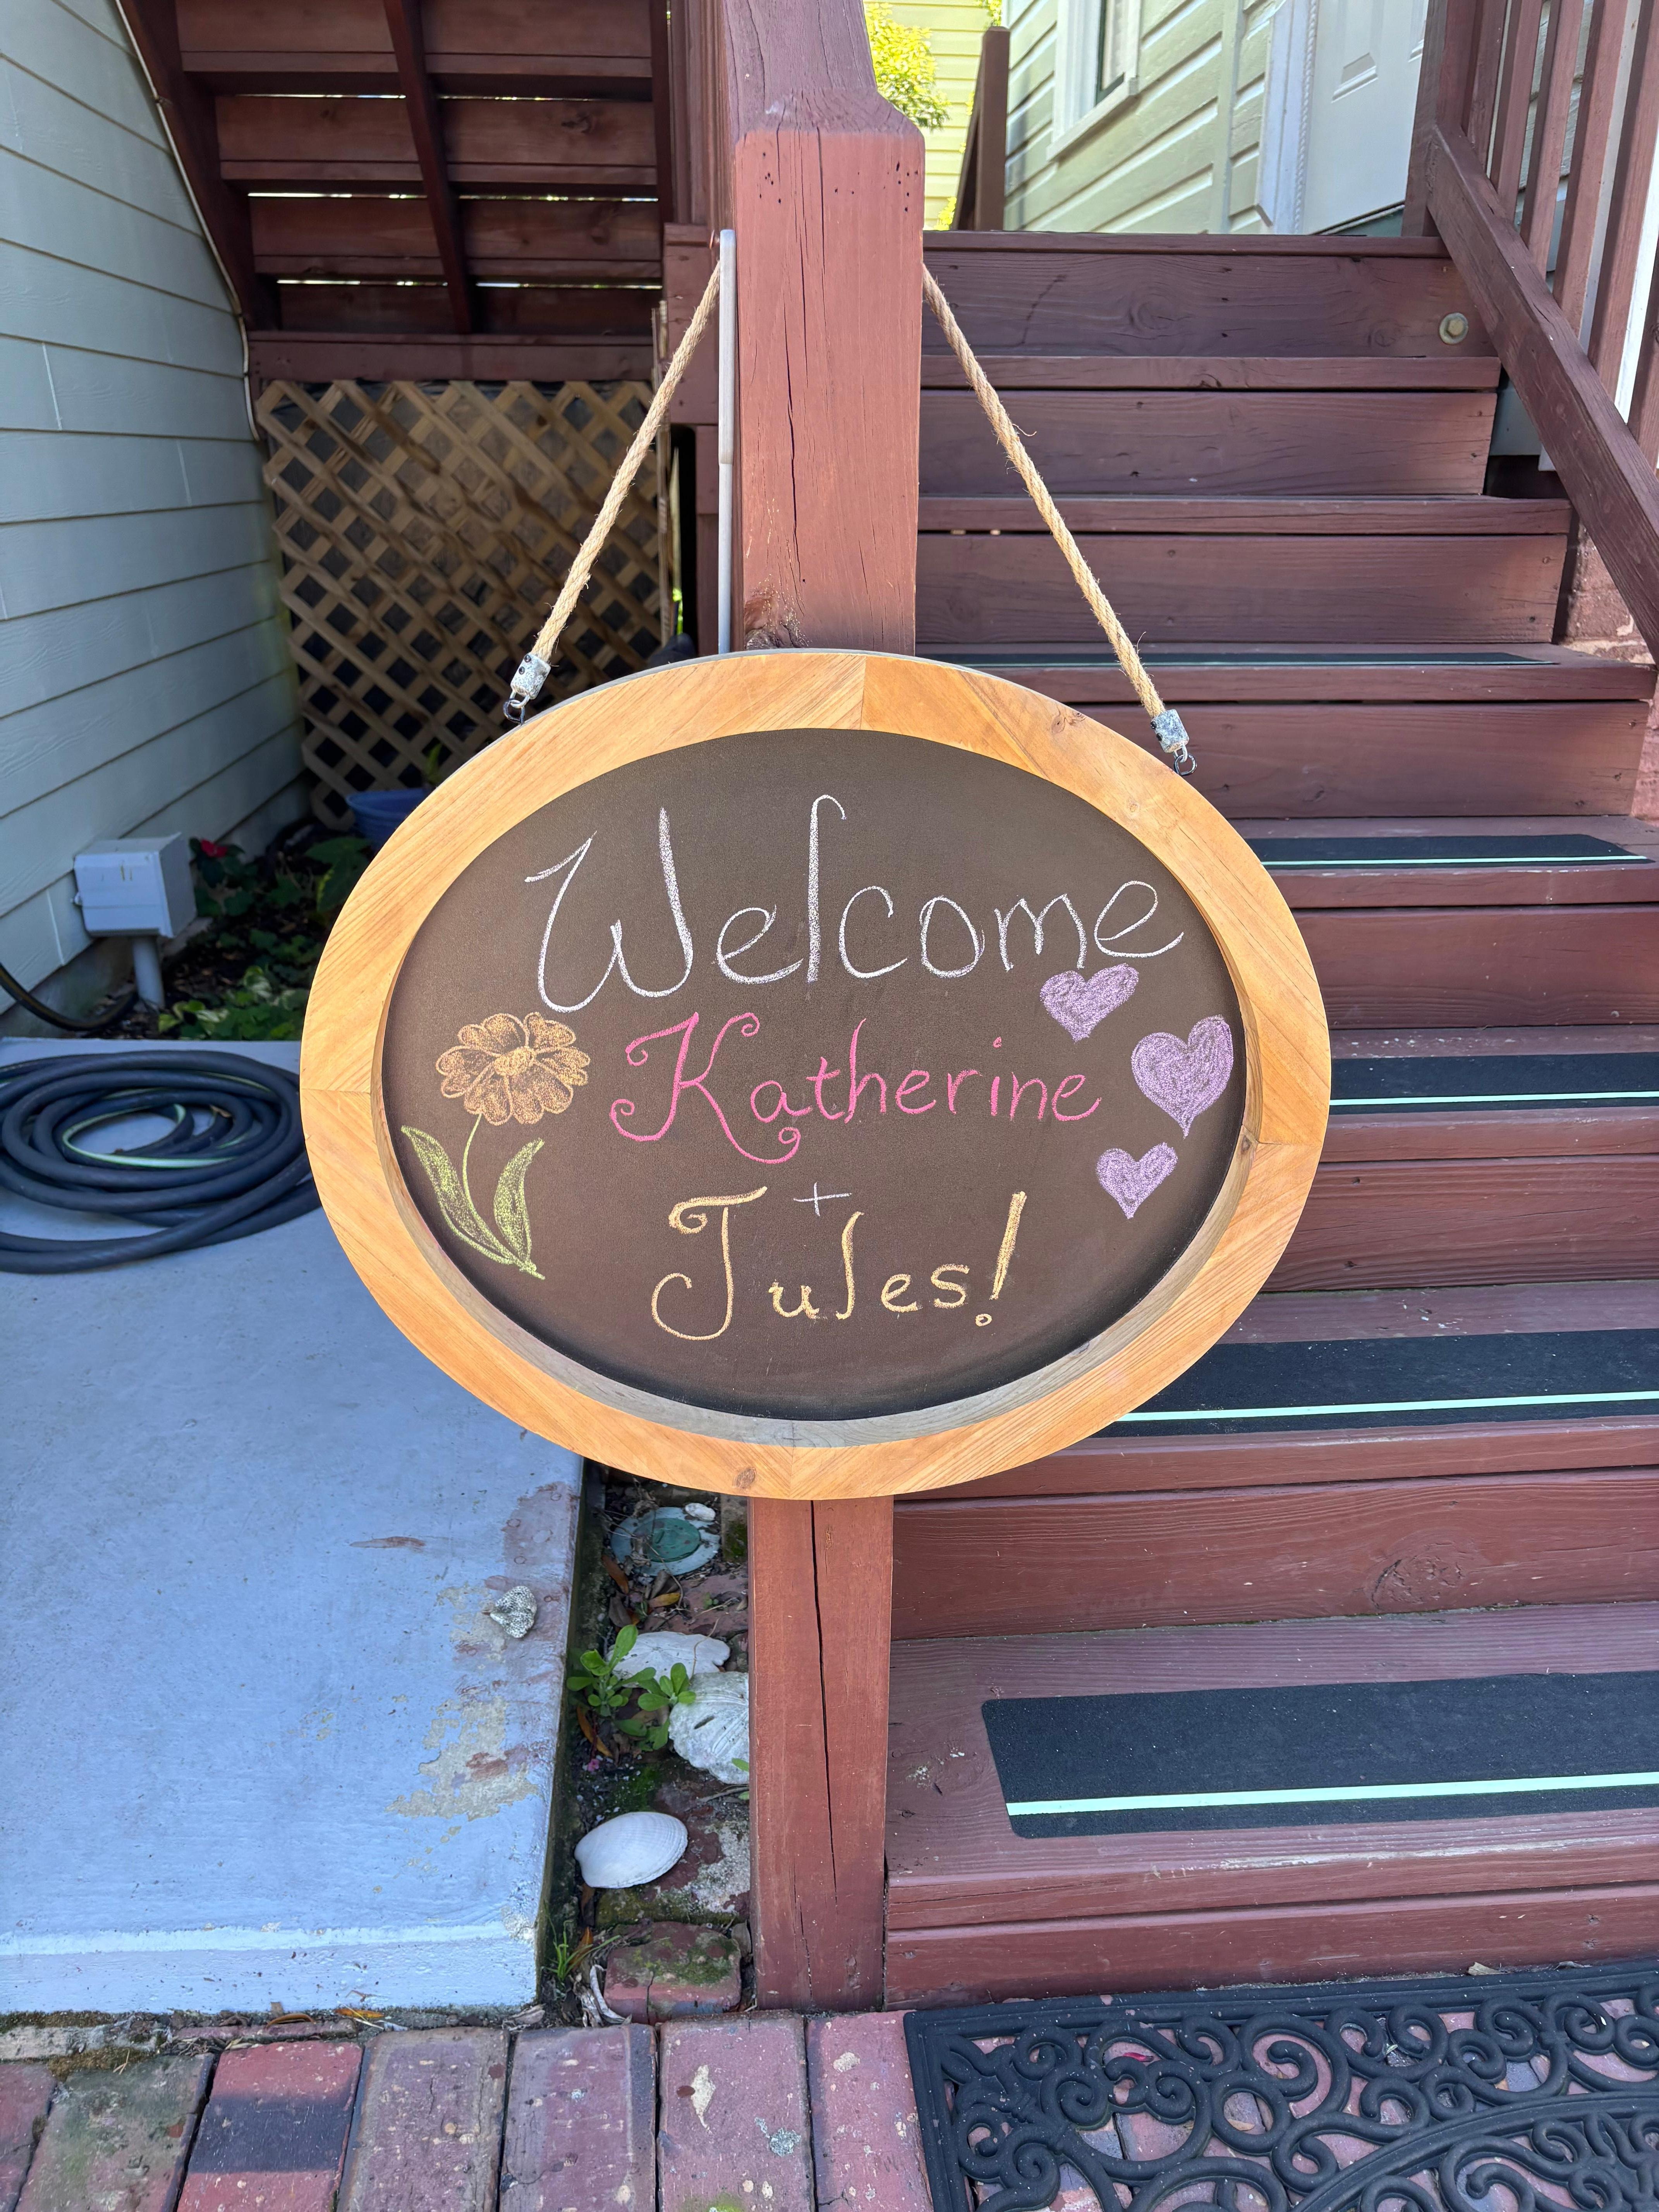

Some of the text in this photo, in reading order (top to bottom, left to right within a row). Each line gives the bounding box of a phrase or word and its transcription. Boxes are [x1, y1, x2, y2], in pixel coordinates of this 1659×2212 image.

[524, 794, 1184, 1013] Welcome
[610, 1012, 1102, 1164] Katherine
[651, 1185, 1027, 1341] Jules!
